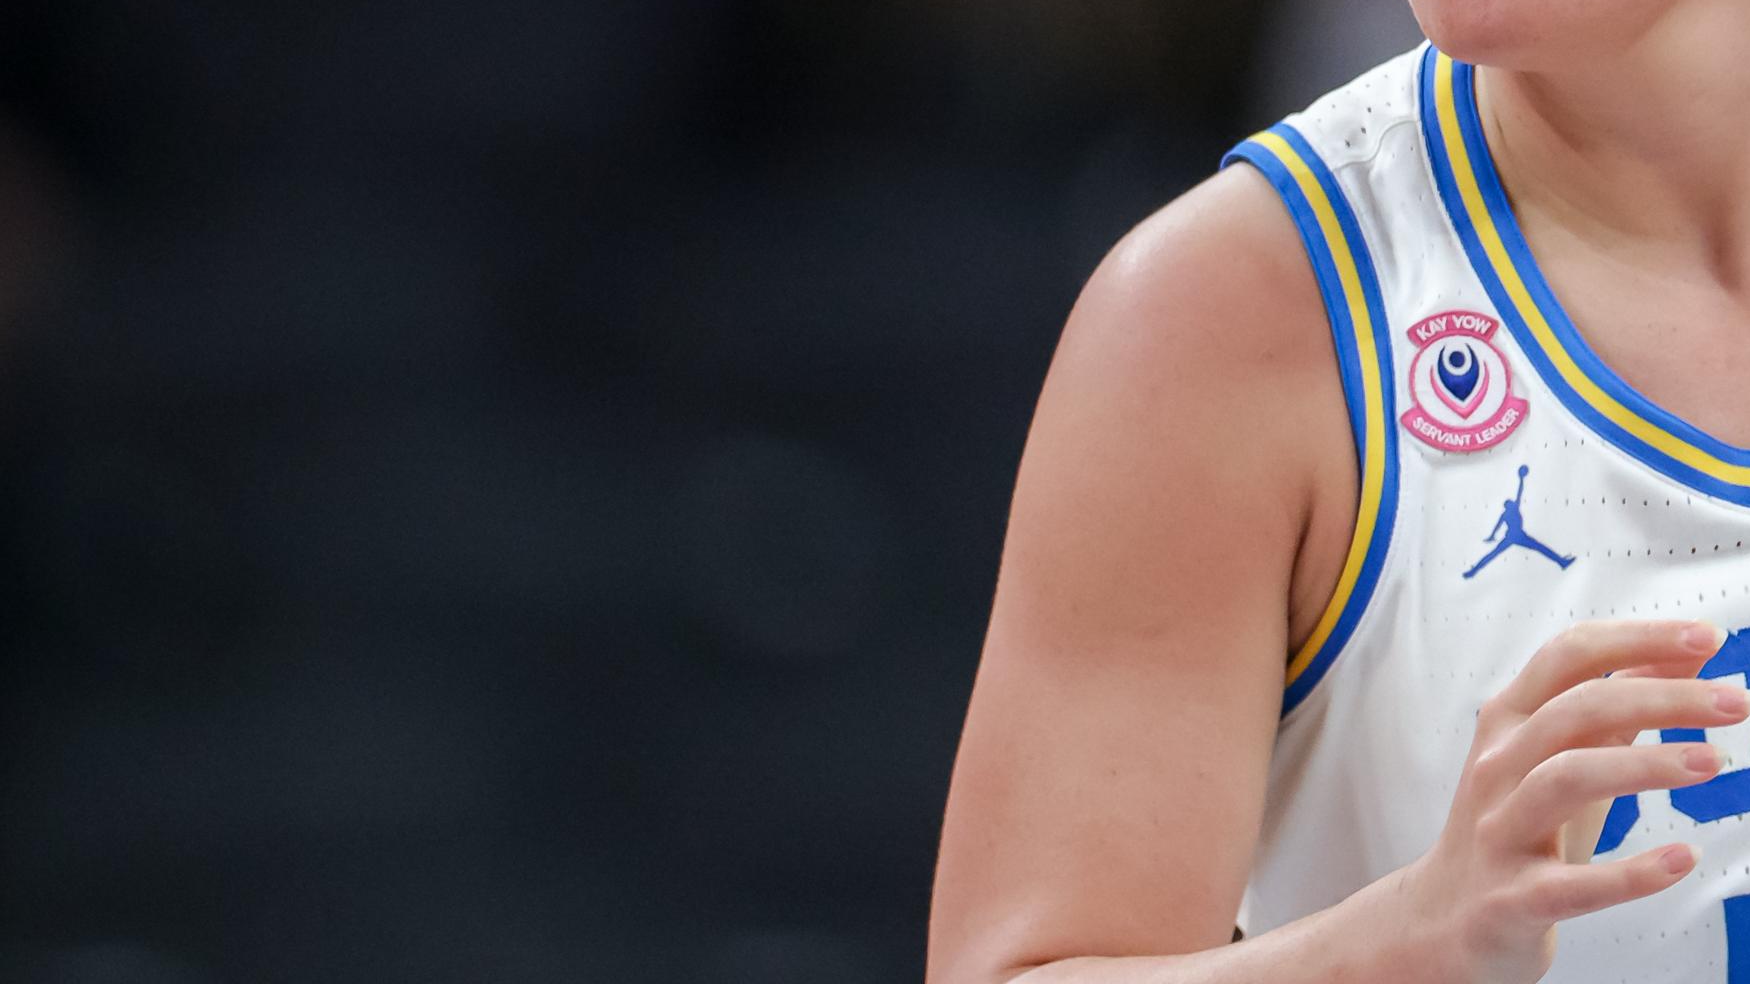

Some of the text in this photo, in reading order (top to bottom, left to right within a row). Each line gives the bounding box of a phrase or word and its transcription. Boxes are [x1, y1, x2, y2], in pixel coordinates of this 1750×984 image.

[1416, 314, 1493, 342] KAY YOW
[1411, 407, 1521, 447] SERVANT LEADER
